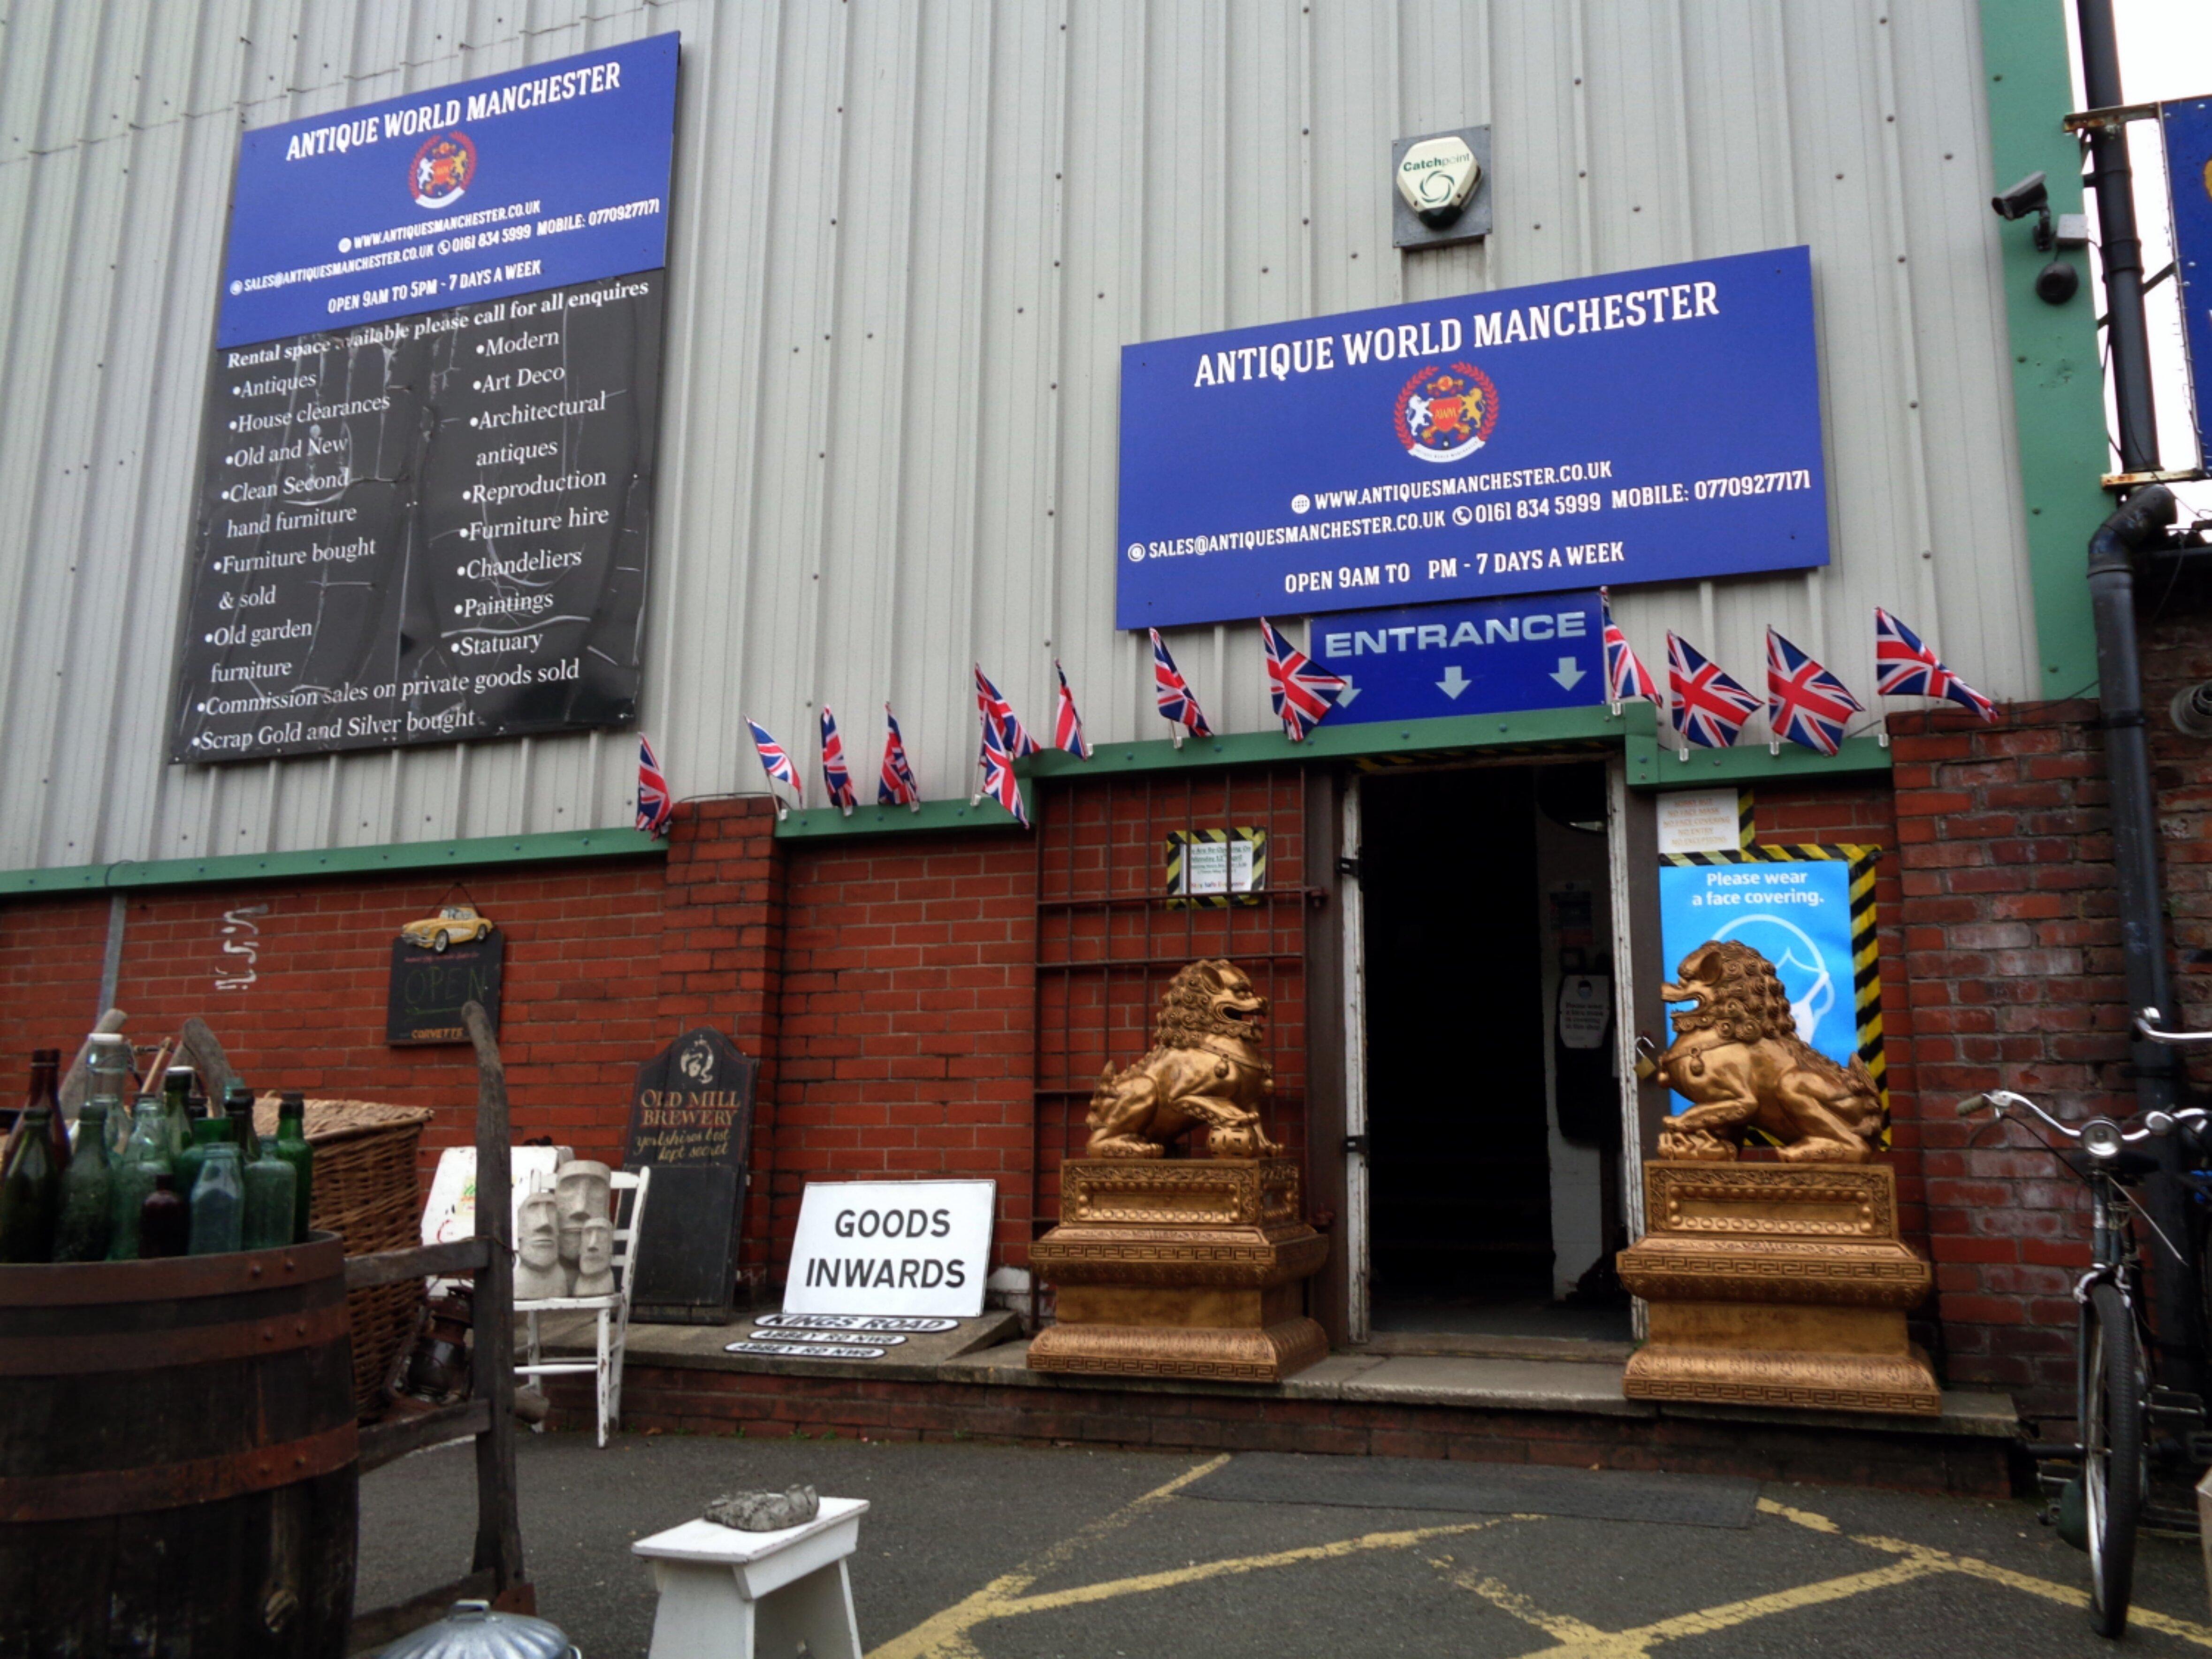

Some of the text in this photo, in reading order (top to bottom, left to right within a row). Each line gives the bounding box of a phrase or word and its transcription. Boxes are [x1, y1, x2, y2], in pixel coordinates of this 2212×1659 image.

[287, 62, 619, 161] ANTIQUE WORLD MANCHESTER
[354, 201, 540, 248] WWW.ANTIQUESMANCHESTER.CO.UK
[245, 199, 659, 291] SALES@ANTIQUESMANCHESTER.CO.UK 0161 834 5999 MOBILE: 07709277171
[328, 295, 359, 313] OPEN
[363, 289, 389, 306] 9AM
[392, 285, 407, 301] TO
[411, 279, 437, 297] 5PM
[450, 275, 457, 290] 7
[460, 269, 491, 288] DAYS
[494, 268, 502, 282] A
[505, 260, 540, 279] WEEK
[229, 283, 648, 367] Rental space vailable please call for all enquires
[1195, 282, 1719, 387] ANTIQUE WORLD MANCHESTER
[486, 332, 558, 356] Modern
[241, 376, 316, 397] Antiques
[482, 368, 565, 392] Art Deco
[238, 397, 389, 432] House clearances
[479, 391, 605, 429] Architectural
[235, 438, 348, 466] Old and New
[476, 443, 557, 466] antiques
[227, 467, 350, 502] Clean Second
[473, 471, 605, 504] Reproduction
[1315, 461, 1611, 509] WWW.ANTIQUESMANCHESTER.CO.UK
[228, 508, 357, 537] hand furniture
[470, 507, 608, 540] Furniture hire
[1150, 470, 1810, 558] SALES@ANTIQUESMANCHESTER.CO.UK 0161 834 5999 MOBILE: 07709277171
[223, 537, 374, 573] Furniture bought
[467, 550, 581, 579] Chandeliers
[1286, 571, 1332, 593] OPEN
[1339, 566, 1379, 588] 9AM
[1385, 563, 1410, 583] TO
[1429, 558, 1457, 579] PM
[1477, 553, 1487, 574] 7
[1495, 550, 1542, 573] DAYS
[1548, 548, 1562, 567] A
[1566, 542, 1624, 565] WEEK
[220, 585, 275, 610] & sold
[465, 592, 553, 617] Paintings
[214, 619, 312, 645] Old garden
[460, 629, 543, 656] Statuary
[1326, 612, 1585, 657] ENTRANCE
[212, 661, 291, 682] furniture
[206, 658, 579, 715] Commission sales on private goods sold
[201, 705, 474, 749] Scrap Gold and Silver bought
[1708, 873, 1808, 885] Please wear
[1693, 889, 1823, 906] a face covering.
[641, 1089, 741, 1109] OLD MILL
[641, 1109, 739, 1126] BREWERY
[836, 1209, 950, 1237] GOODS
[806, 1259, 965, 1288] INWARDS
[768, 1315, 948, 1330] KINGS ROAD
